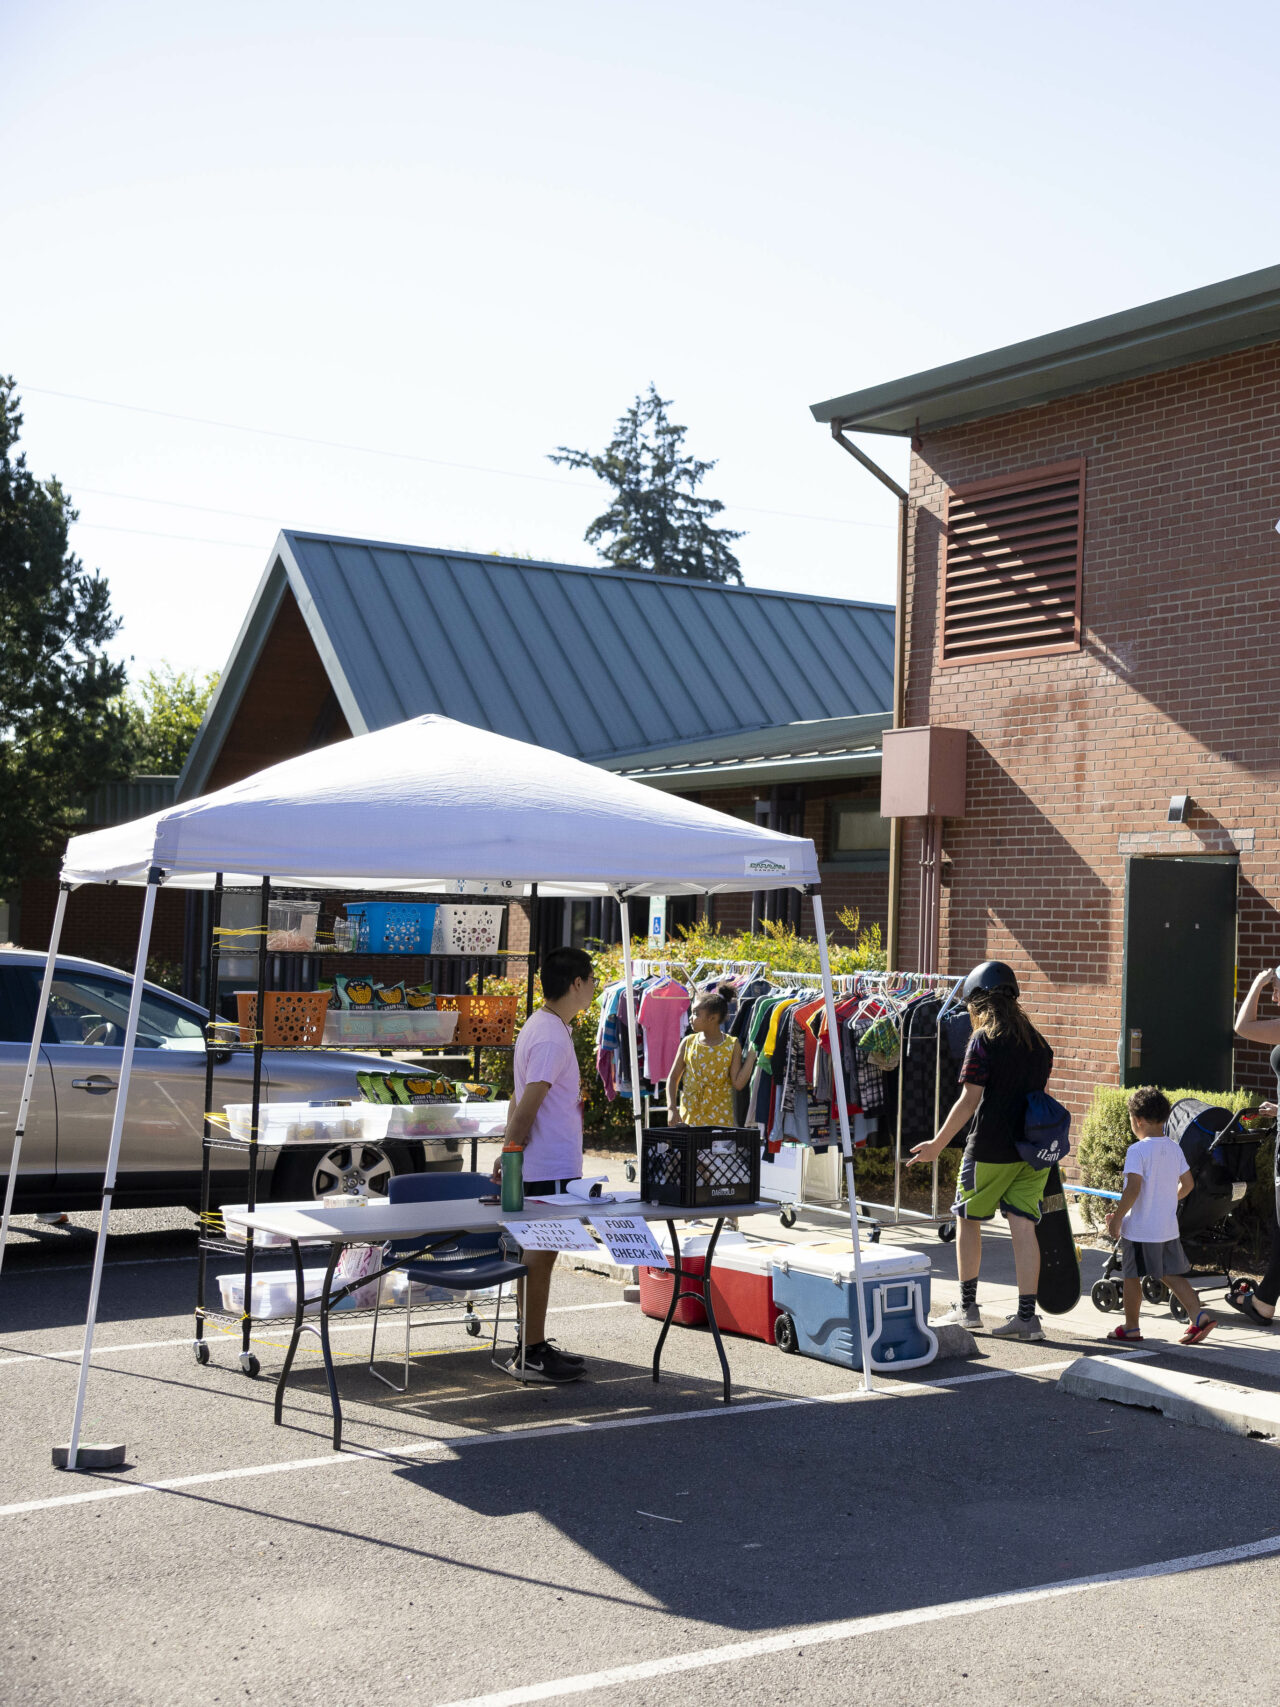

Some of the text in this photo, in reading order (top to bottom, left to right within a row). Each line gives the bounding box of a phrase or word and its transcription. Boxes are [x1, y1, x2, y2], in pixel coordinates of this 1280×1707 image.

[605, 1219, 635, 1229] FOOD
[606, 1233, 648, 1244] PANTRY
[612, 1247, 664, 1261] CHECK-IN
